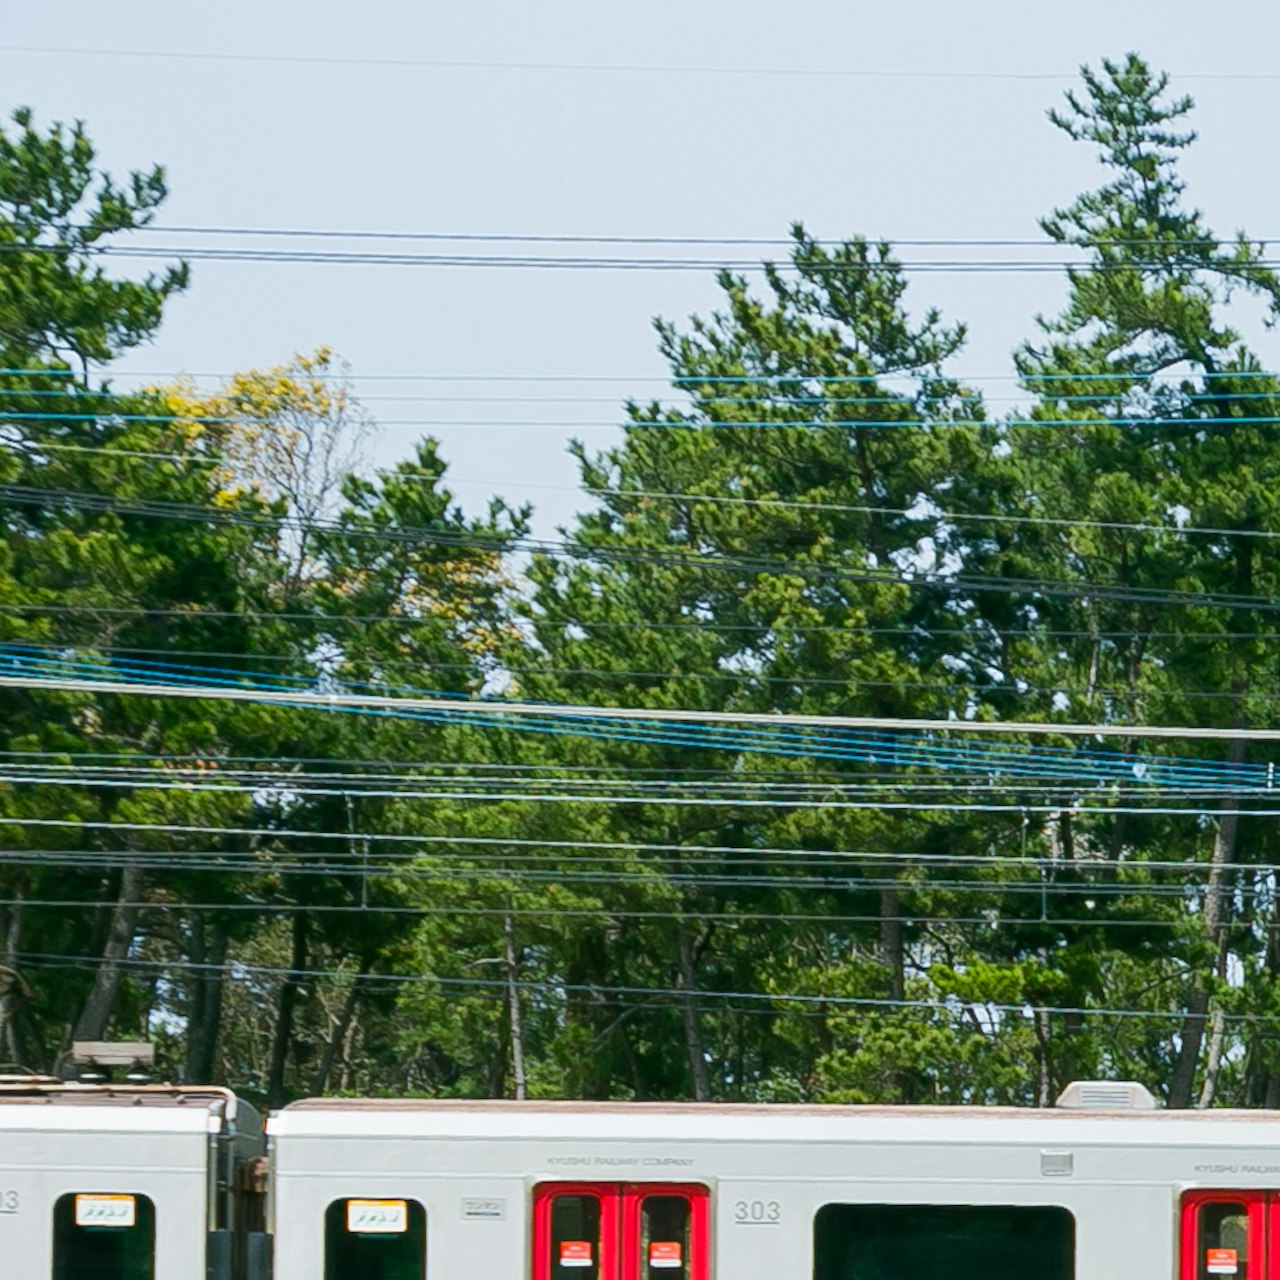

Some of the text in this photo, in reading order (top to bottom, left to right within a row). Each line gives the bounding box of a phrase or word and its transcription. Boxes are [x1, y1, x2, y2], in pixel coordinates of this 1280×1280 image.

[547, 1157, 695, 1167] KYUSHU RAILWAY COMPANY
[1194, 1165, 1239, 1173] KYUSHU
[734, 1200, 781, 1221] 303
